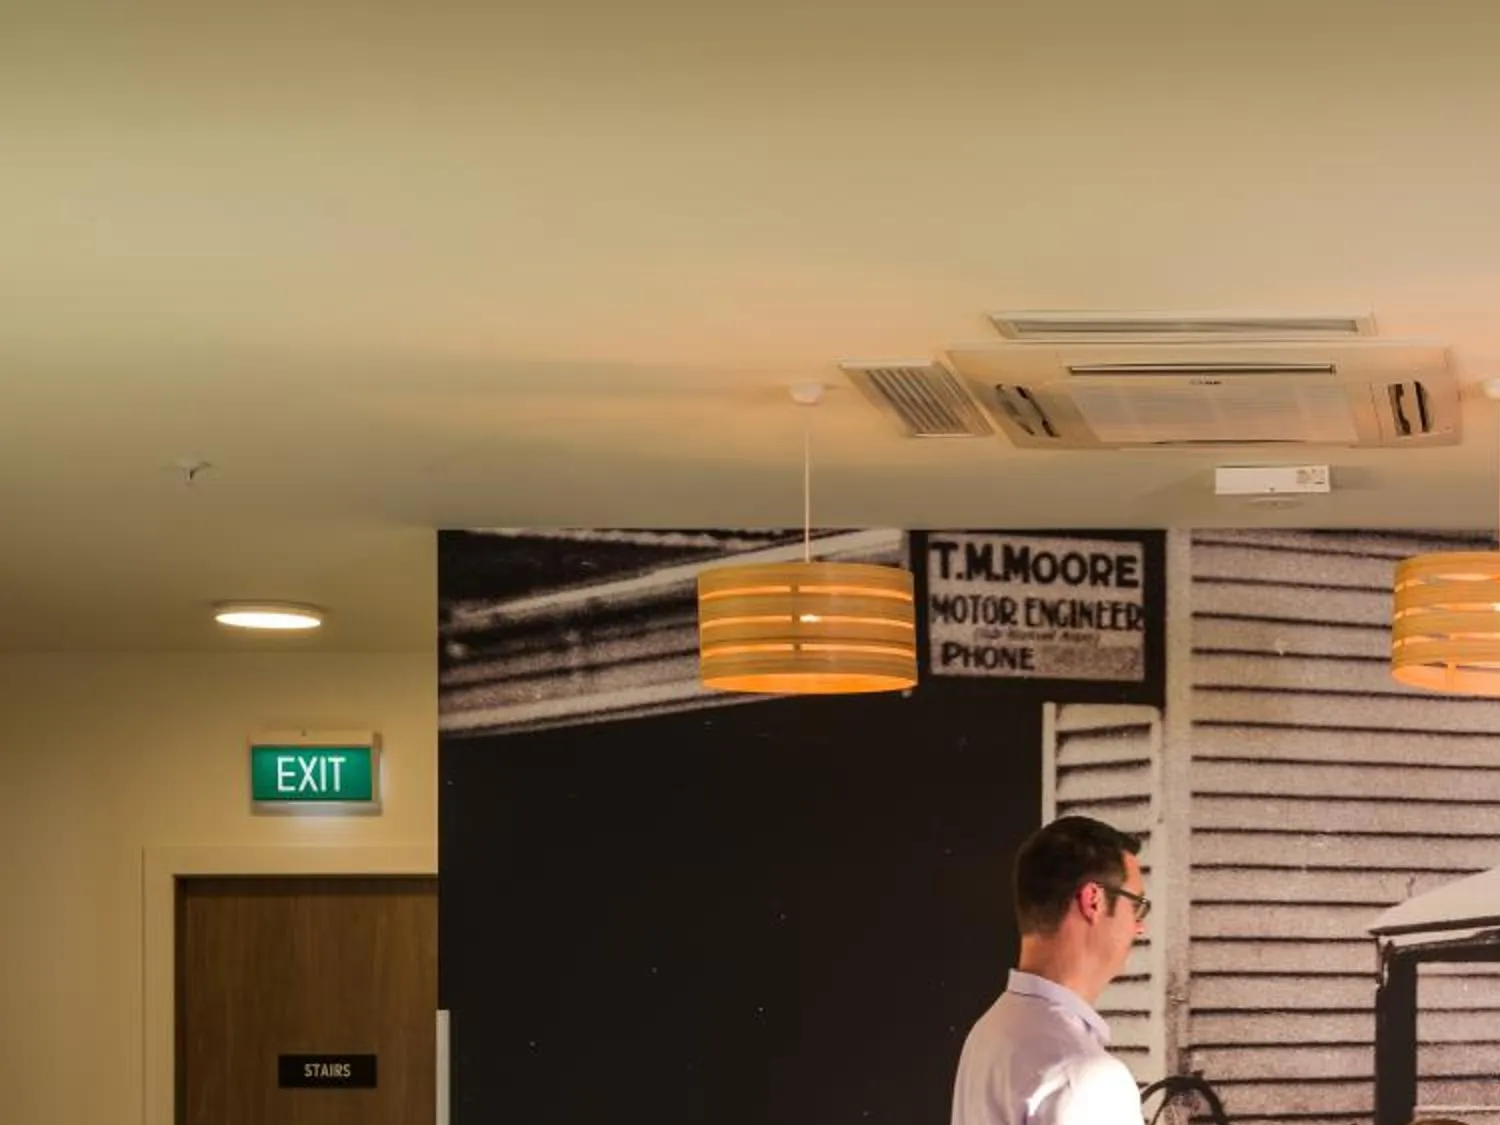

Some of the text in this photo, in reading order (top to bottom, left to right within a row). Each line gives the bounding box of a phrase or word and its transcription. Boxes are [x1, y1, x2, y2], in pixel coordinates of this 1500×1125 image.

[932, 594, 1145, 631] MOTOR ENGINEER
[941, 641, 1036, 670] PHONE
[277, 756, 346, 792] EXIT
[304, 1063, 351, 1077] STAIRS
